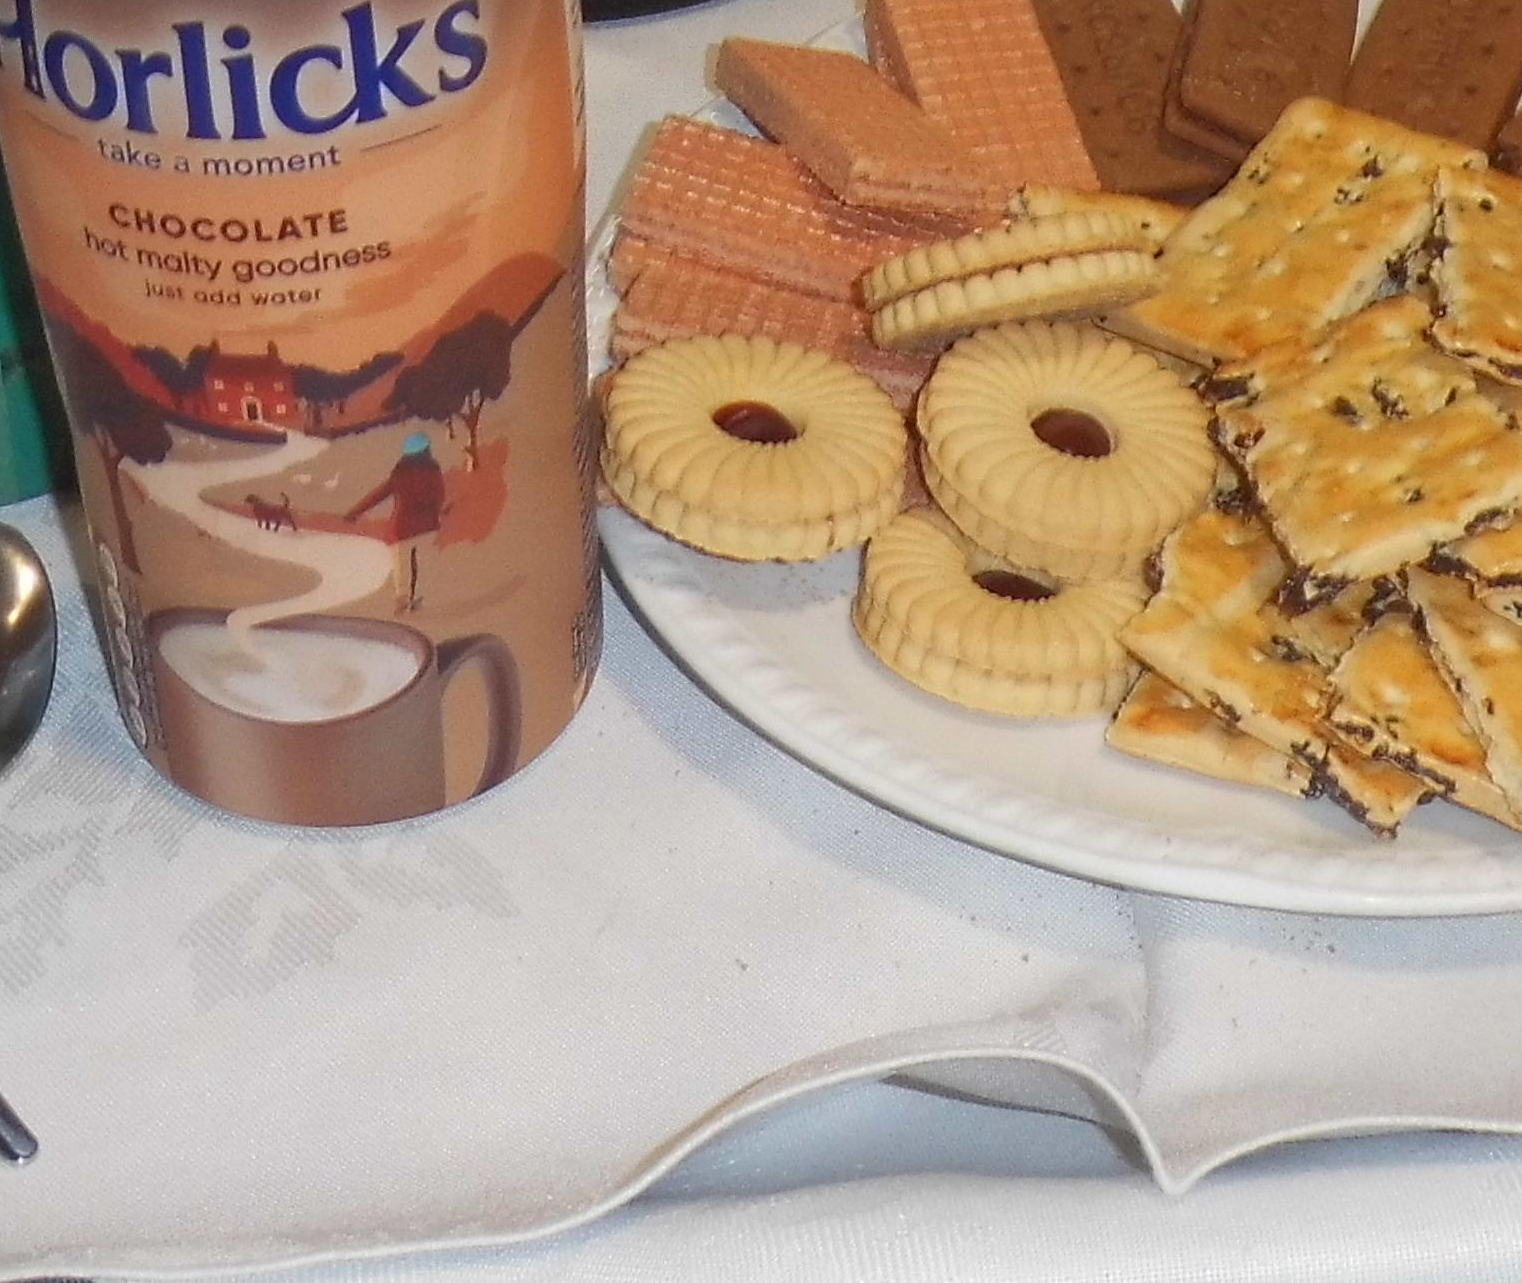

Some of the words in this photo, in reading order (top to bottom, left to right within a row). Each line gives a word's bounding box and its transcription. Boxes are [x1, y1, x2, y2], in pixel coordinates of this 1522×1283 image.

[97, 138, 161, 169] take
[175, 157, 190, 173] a
[203, 145, 342, 176] moment
[108, 202, 350, 243] CHOCOLATE
[83, 225, 128, 261] hot
[136, 246, 223, 281] malty
[231, 240, 392, 284] goodness
[144, 278, 184, 301] just
[193, 287, 241, 305] add
[251, 286, 322, 306] water
